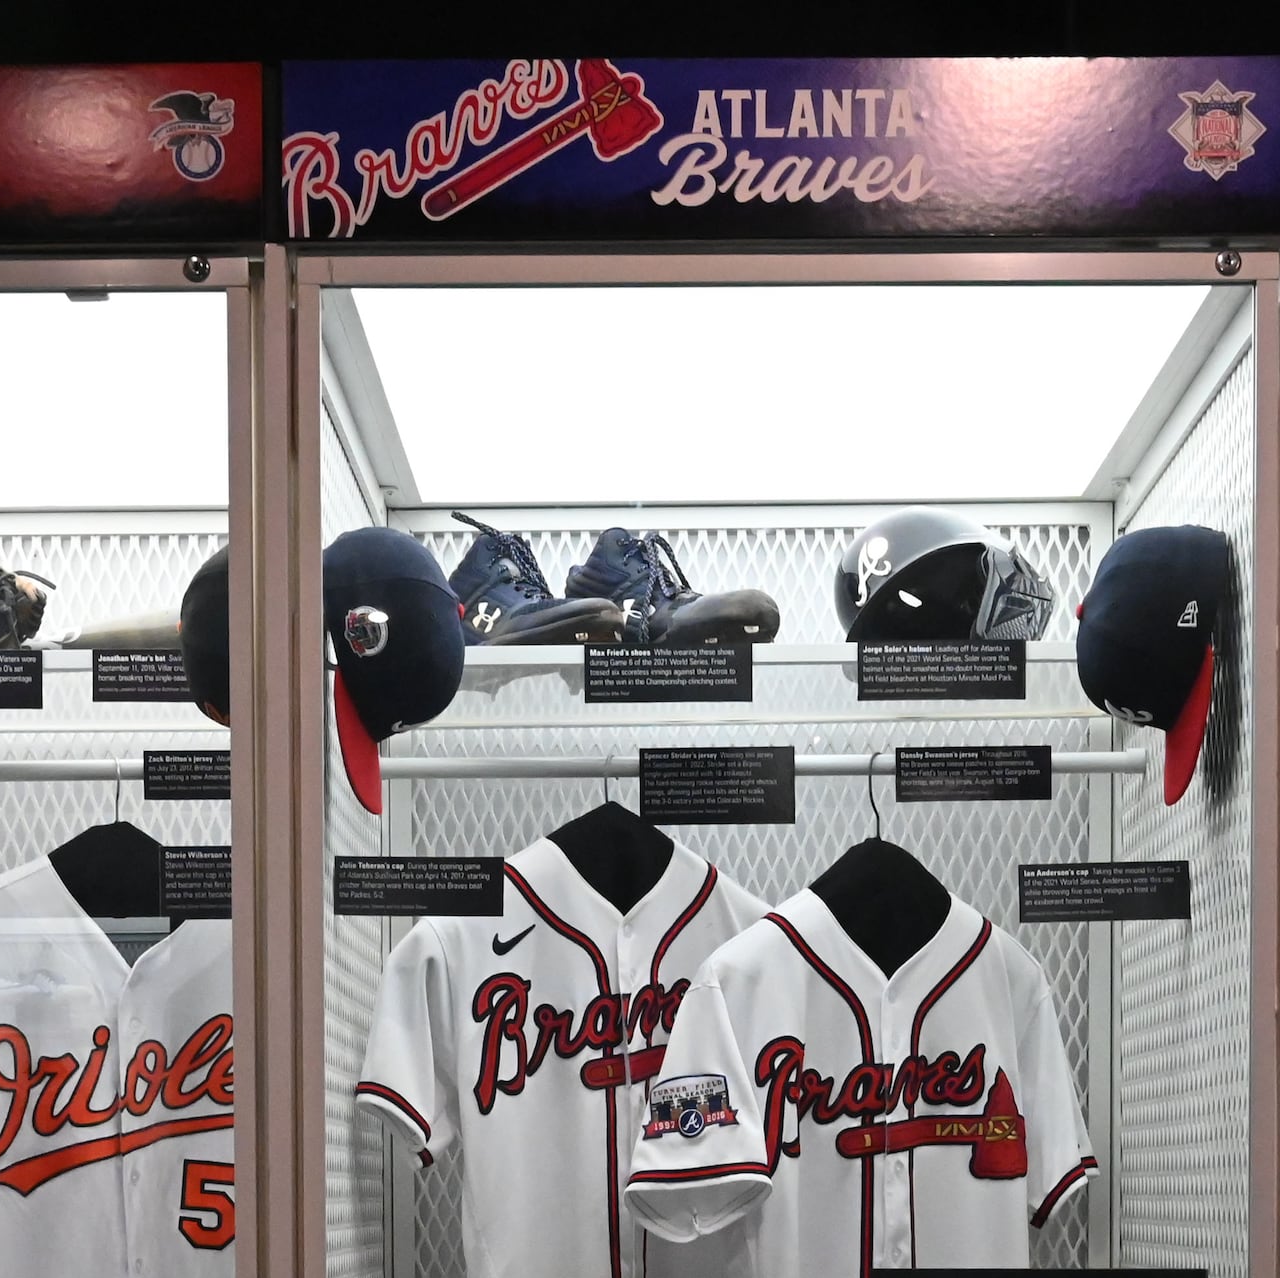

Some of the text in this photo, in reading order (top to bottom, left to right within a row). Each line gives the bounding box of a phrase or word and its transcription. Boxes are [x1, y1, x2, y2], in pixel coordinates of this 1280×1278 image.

[691, 89, 916, 138] ATLANTA
[281, 58, 569, 238] Braves
[651, 133, 937, 206] Braves
[607, 648, 629, 656] Fried's
[863, 646, 882, 654] Jorge
[909, 645, 932, 653] helmet
[653, 1080, 723, 1097] TURNER FIELD
[662, 1089, 714, 1101] FINAL SEASON
[755, 1034, 987, 1176] Braves
[654, 1121, 675, 1131] 1997
[707, 1111, 725, 1122] 2016
